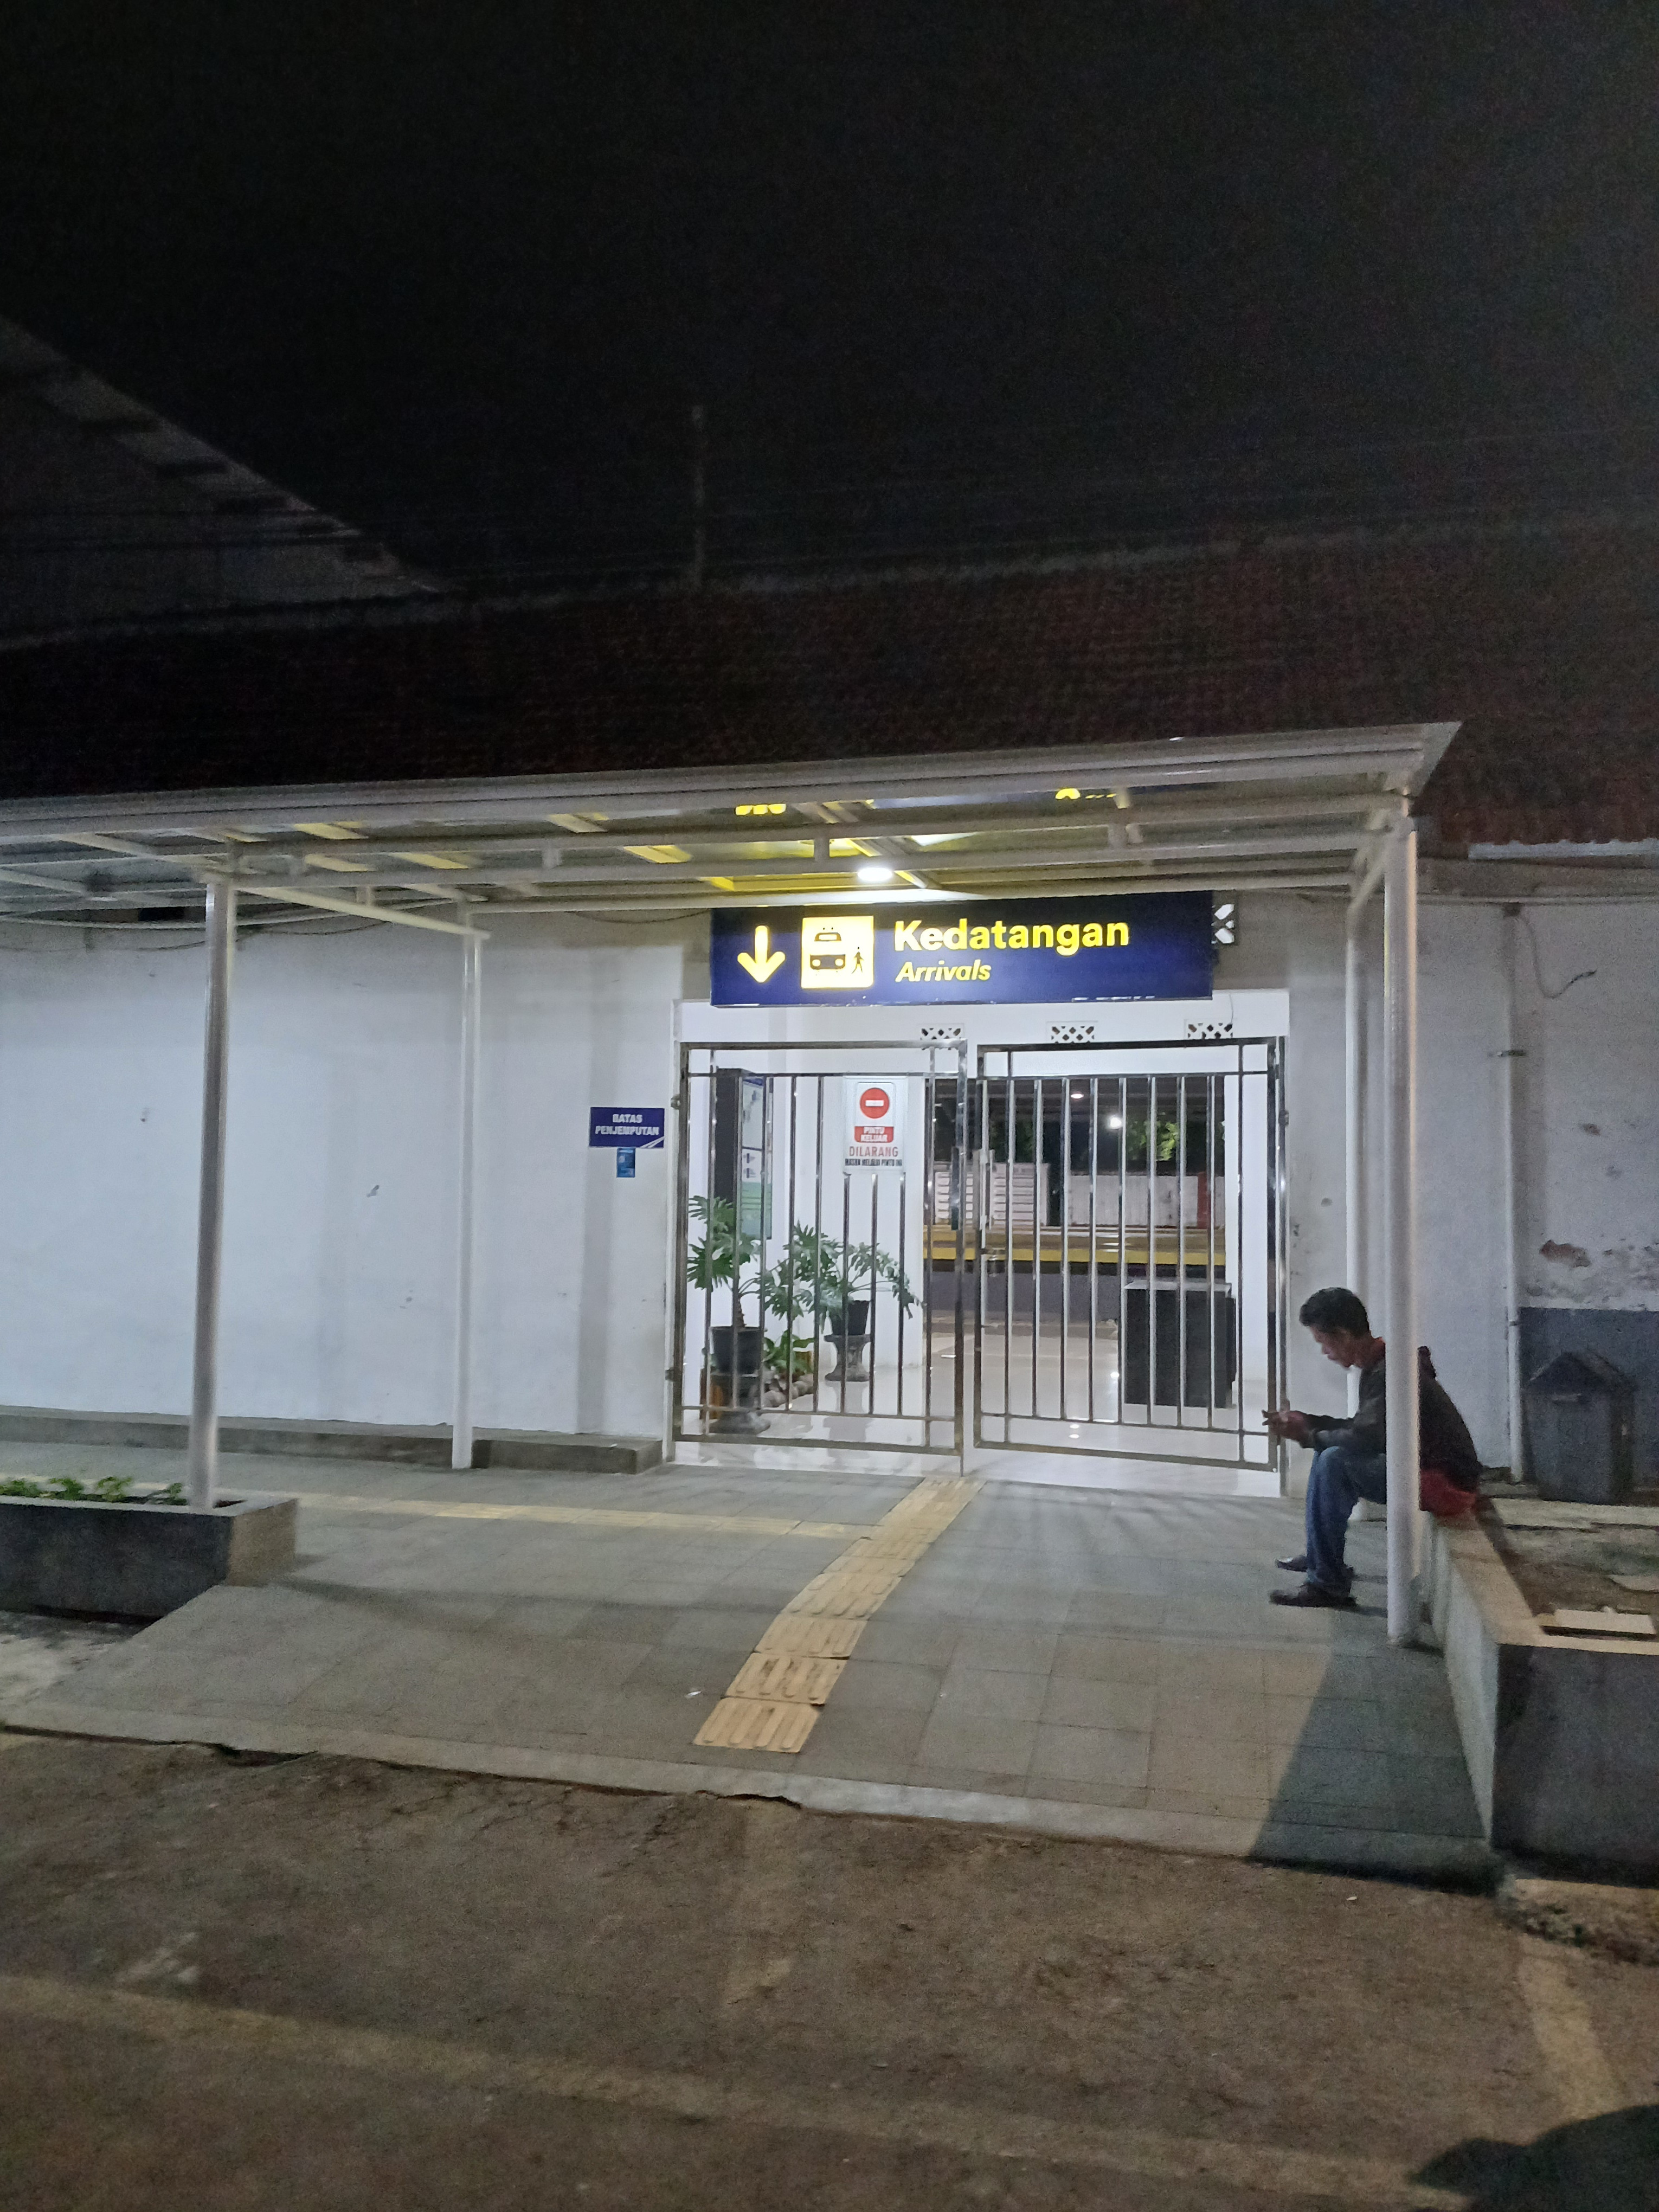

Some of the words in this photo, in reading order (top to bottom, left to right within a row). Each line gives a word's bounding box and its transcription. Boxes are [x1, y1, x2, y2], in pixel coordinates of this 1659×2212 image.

[895, 918, 1129, 956] Kedatangan
[895, 959, 992, 982] Arrivals
[612, 1114, 643, 1123] BATAS
[595, 1126, 660, 1135] PENJEMPUTAN
[849, 1146, 898, 1157] DILARANG
